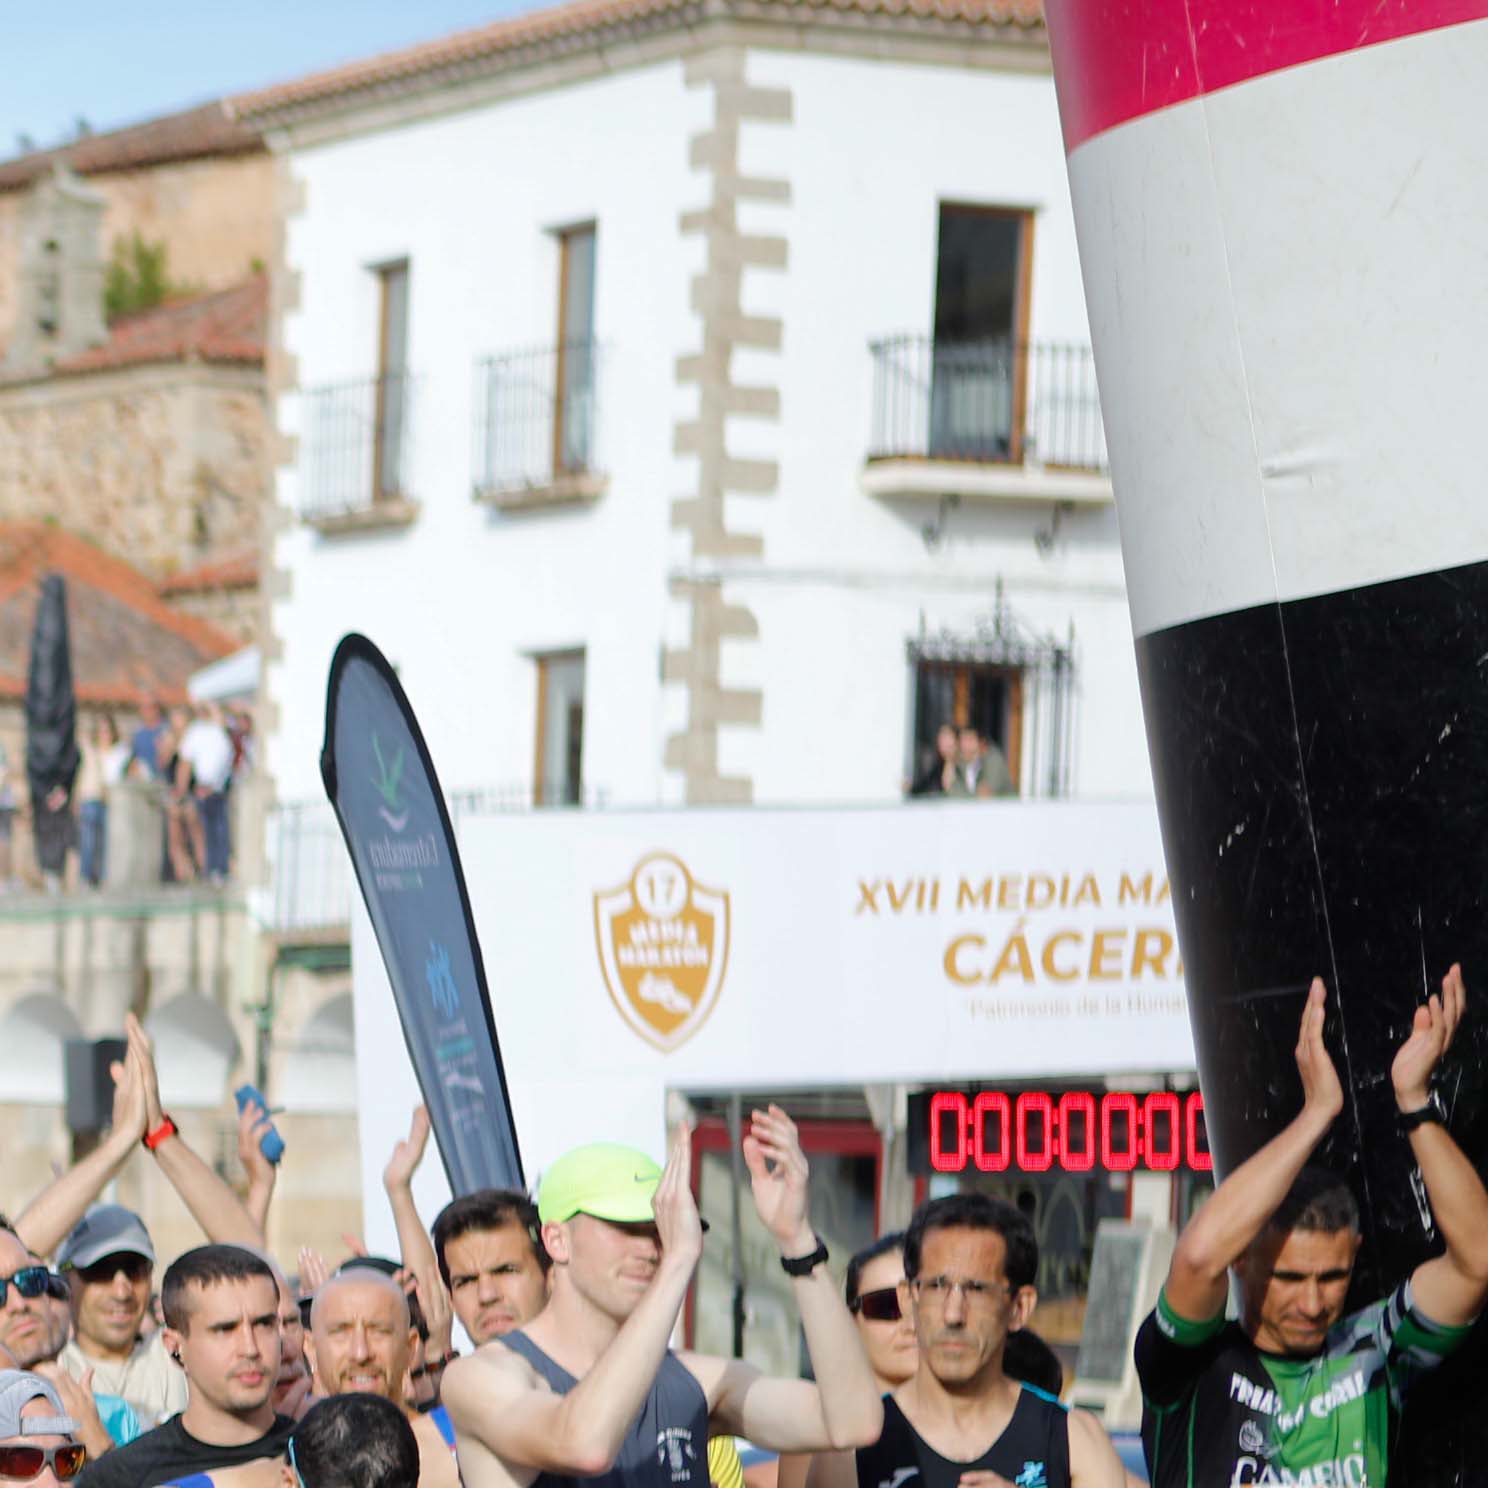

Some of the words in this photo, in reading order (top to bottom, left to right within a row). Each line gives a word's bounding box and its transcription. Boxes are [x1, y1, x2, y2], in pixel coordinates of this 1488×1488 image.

[854, 875, 940, 915] XVII
[955, 872, 1101, 911] MEDIA
[942, 914, 1185, 986] CÁCER
